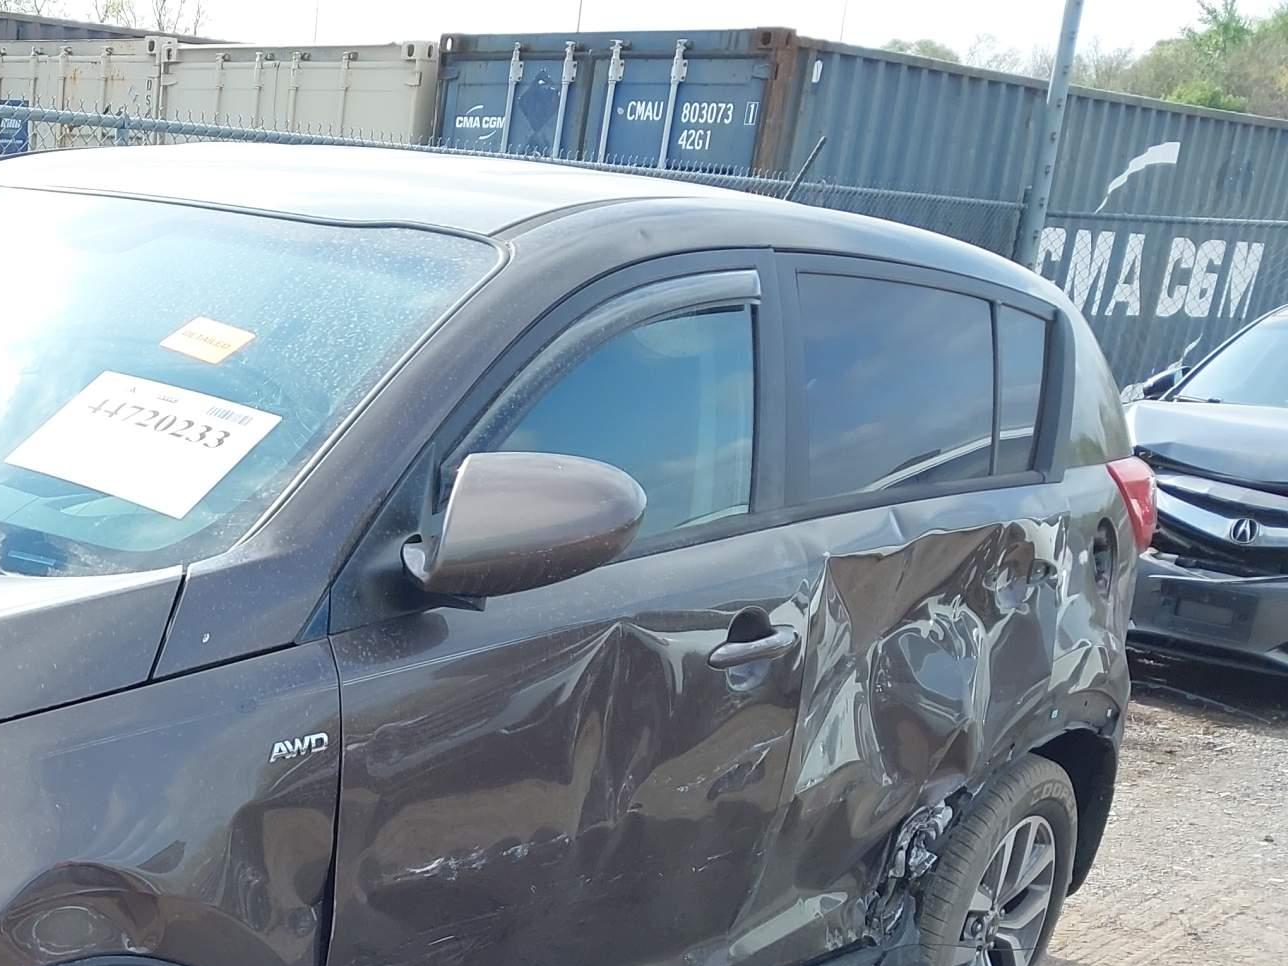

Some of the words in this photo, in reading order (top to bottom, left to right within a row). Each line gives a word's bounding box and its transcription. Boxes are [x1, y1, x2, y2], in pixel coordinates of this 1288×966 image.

[455, 116, 481, 129] CMA
[482, 116, 506, 129] CGM
[626, 101, 664, 121] CMAU
[681, 102, 734, 124] 803073
[678, 129, 712, 151] 42G1
[1034, 227, 1146, 317] CMA
[1155, 237, 1265, 319] CGM
[269, 732, 329, 763] AWD
